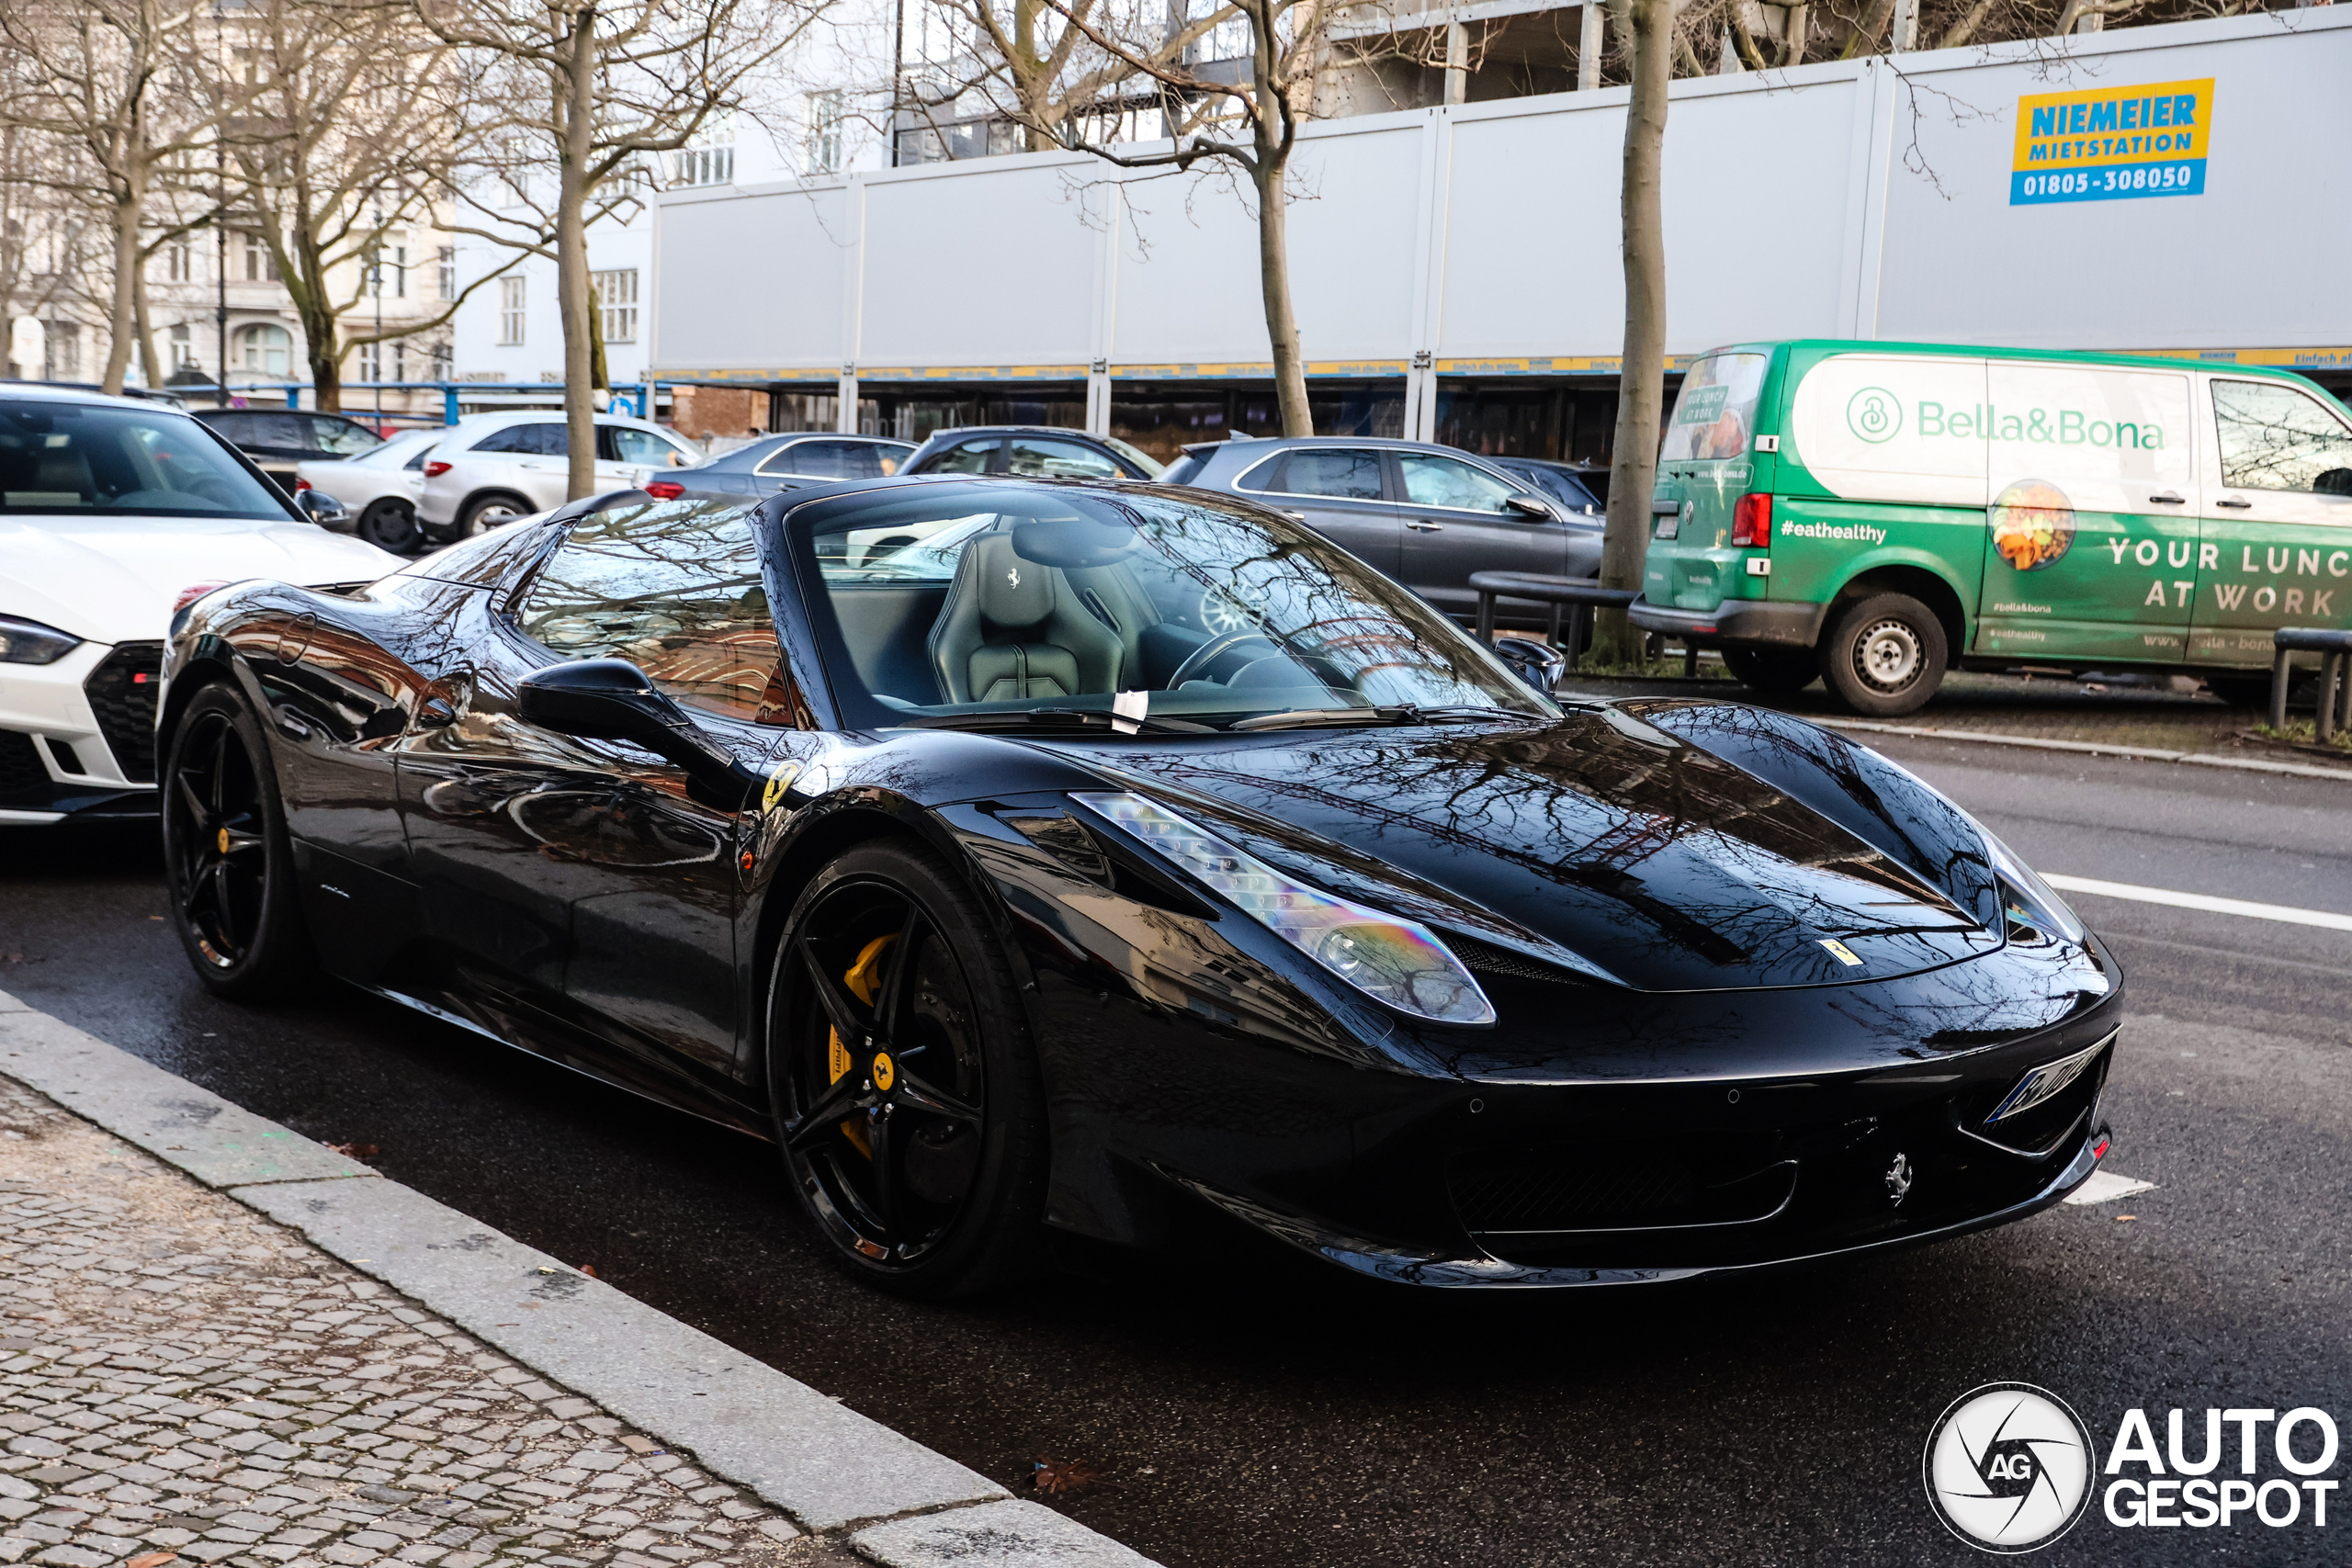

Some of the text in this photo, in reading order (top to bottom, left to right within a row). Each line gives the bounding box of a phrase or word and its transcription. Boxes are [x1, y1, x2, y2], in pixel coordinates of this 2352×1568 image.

[2030, 94, 2197, 137] NIEMEIER
[2029, 132, 2192, 161] MIETSTATION
[2024, 165, 2191, 197] 01805-308050
[1918, 400, 2165, 450] Bella&Bona
[1781, 519, 1887, 546] #eathealthy
[2109, 537, 2349, 578] YOUR LUNC
[2144, 580, 2334, 616] AT WORK
